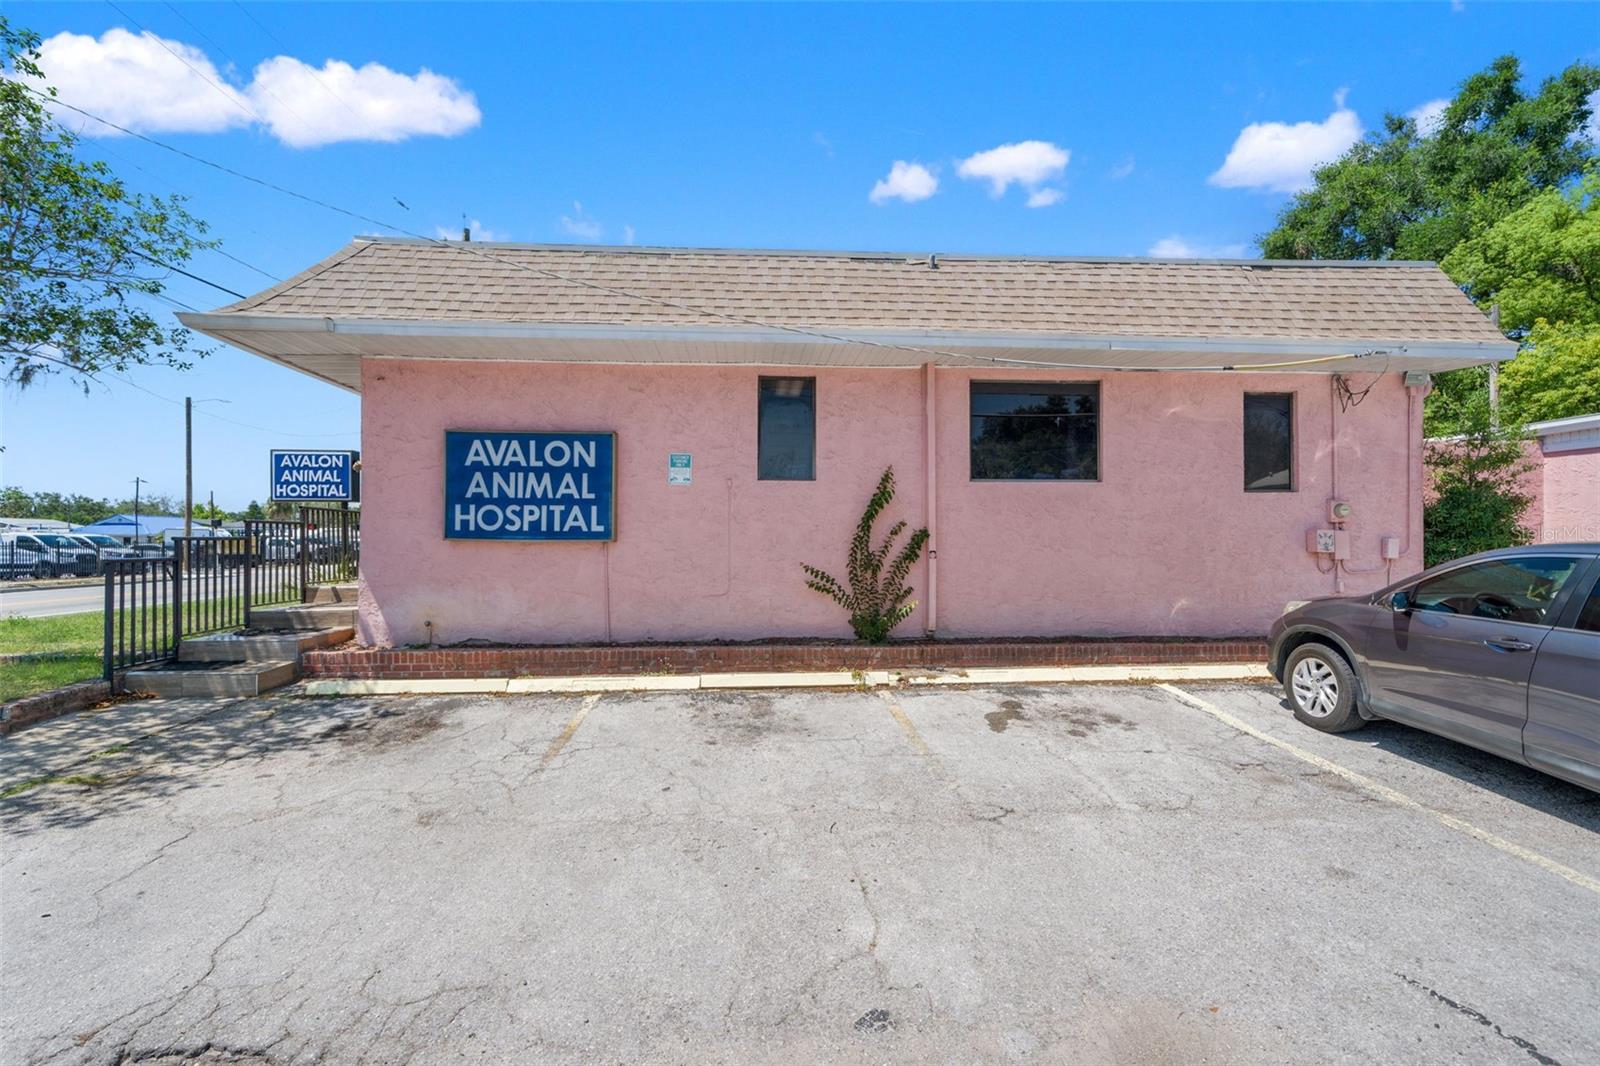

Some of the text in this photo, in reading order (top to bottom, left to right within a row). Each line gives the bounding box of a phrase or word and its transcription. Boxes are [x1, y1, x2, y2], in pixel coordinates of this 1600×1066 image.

[280, 454, 343, 468] AVALON
[464, 439, 596, 468] AVALON
[281, 469, 341, 482] ANIMAL
[465, 471, 596, 499] ANIMAL
[276, 484, 347, 497] HOSPITAL
[454, 504, 605, 532] HOSPITAL
